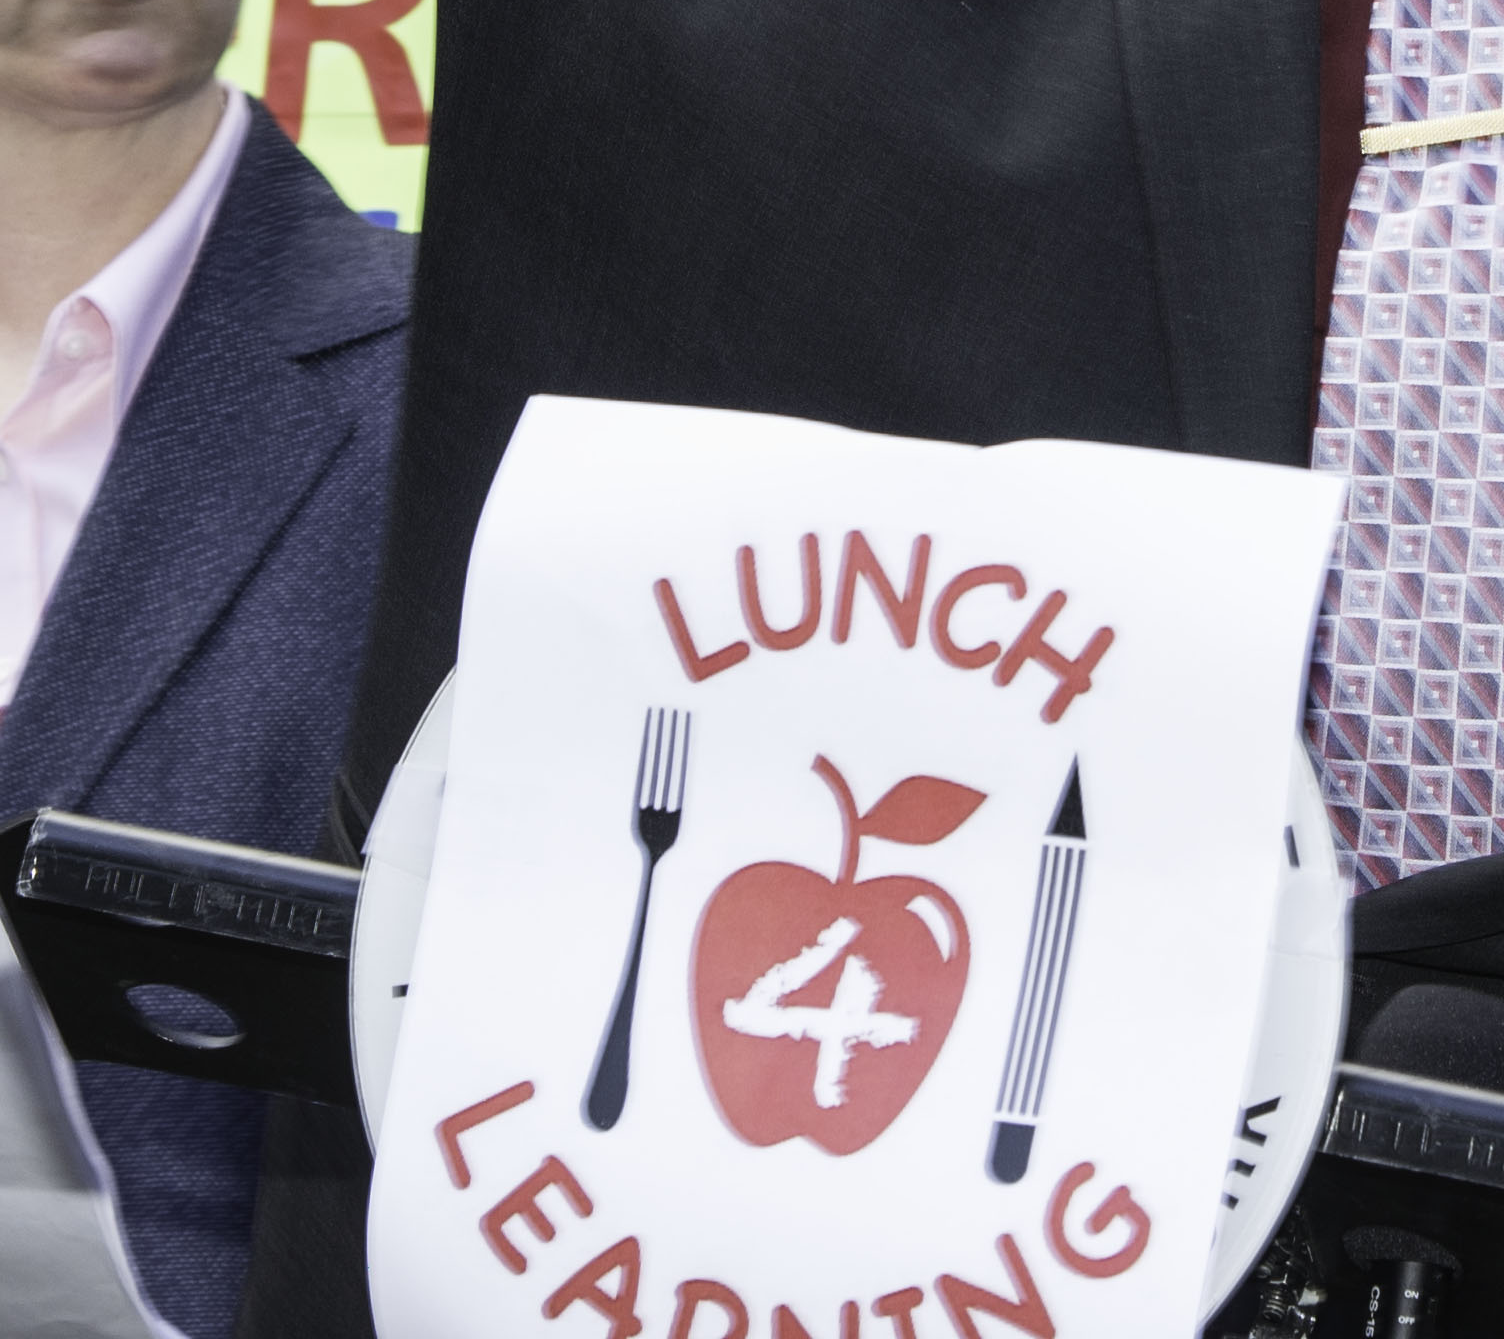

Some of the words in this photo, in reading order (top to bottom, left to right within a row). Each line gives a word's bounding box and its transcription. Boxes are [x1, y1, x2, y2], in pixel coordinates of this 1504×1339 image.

[650, 528, 1117, 726] LUNCH
[721, 915, 924, 1110] 4
[1364, 1284, 1381, 1338] CS-15
[1397, 1314, 1416, 1326] OFF
[1403, 1288, 1420, 1300] ON
